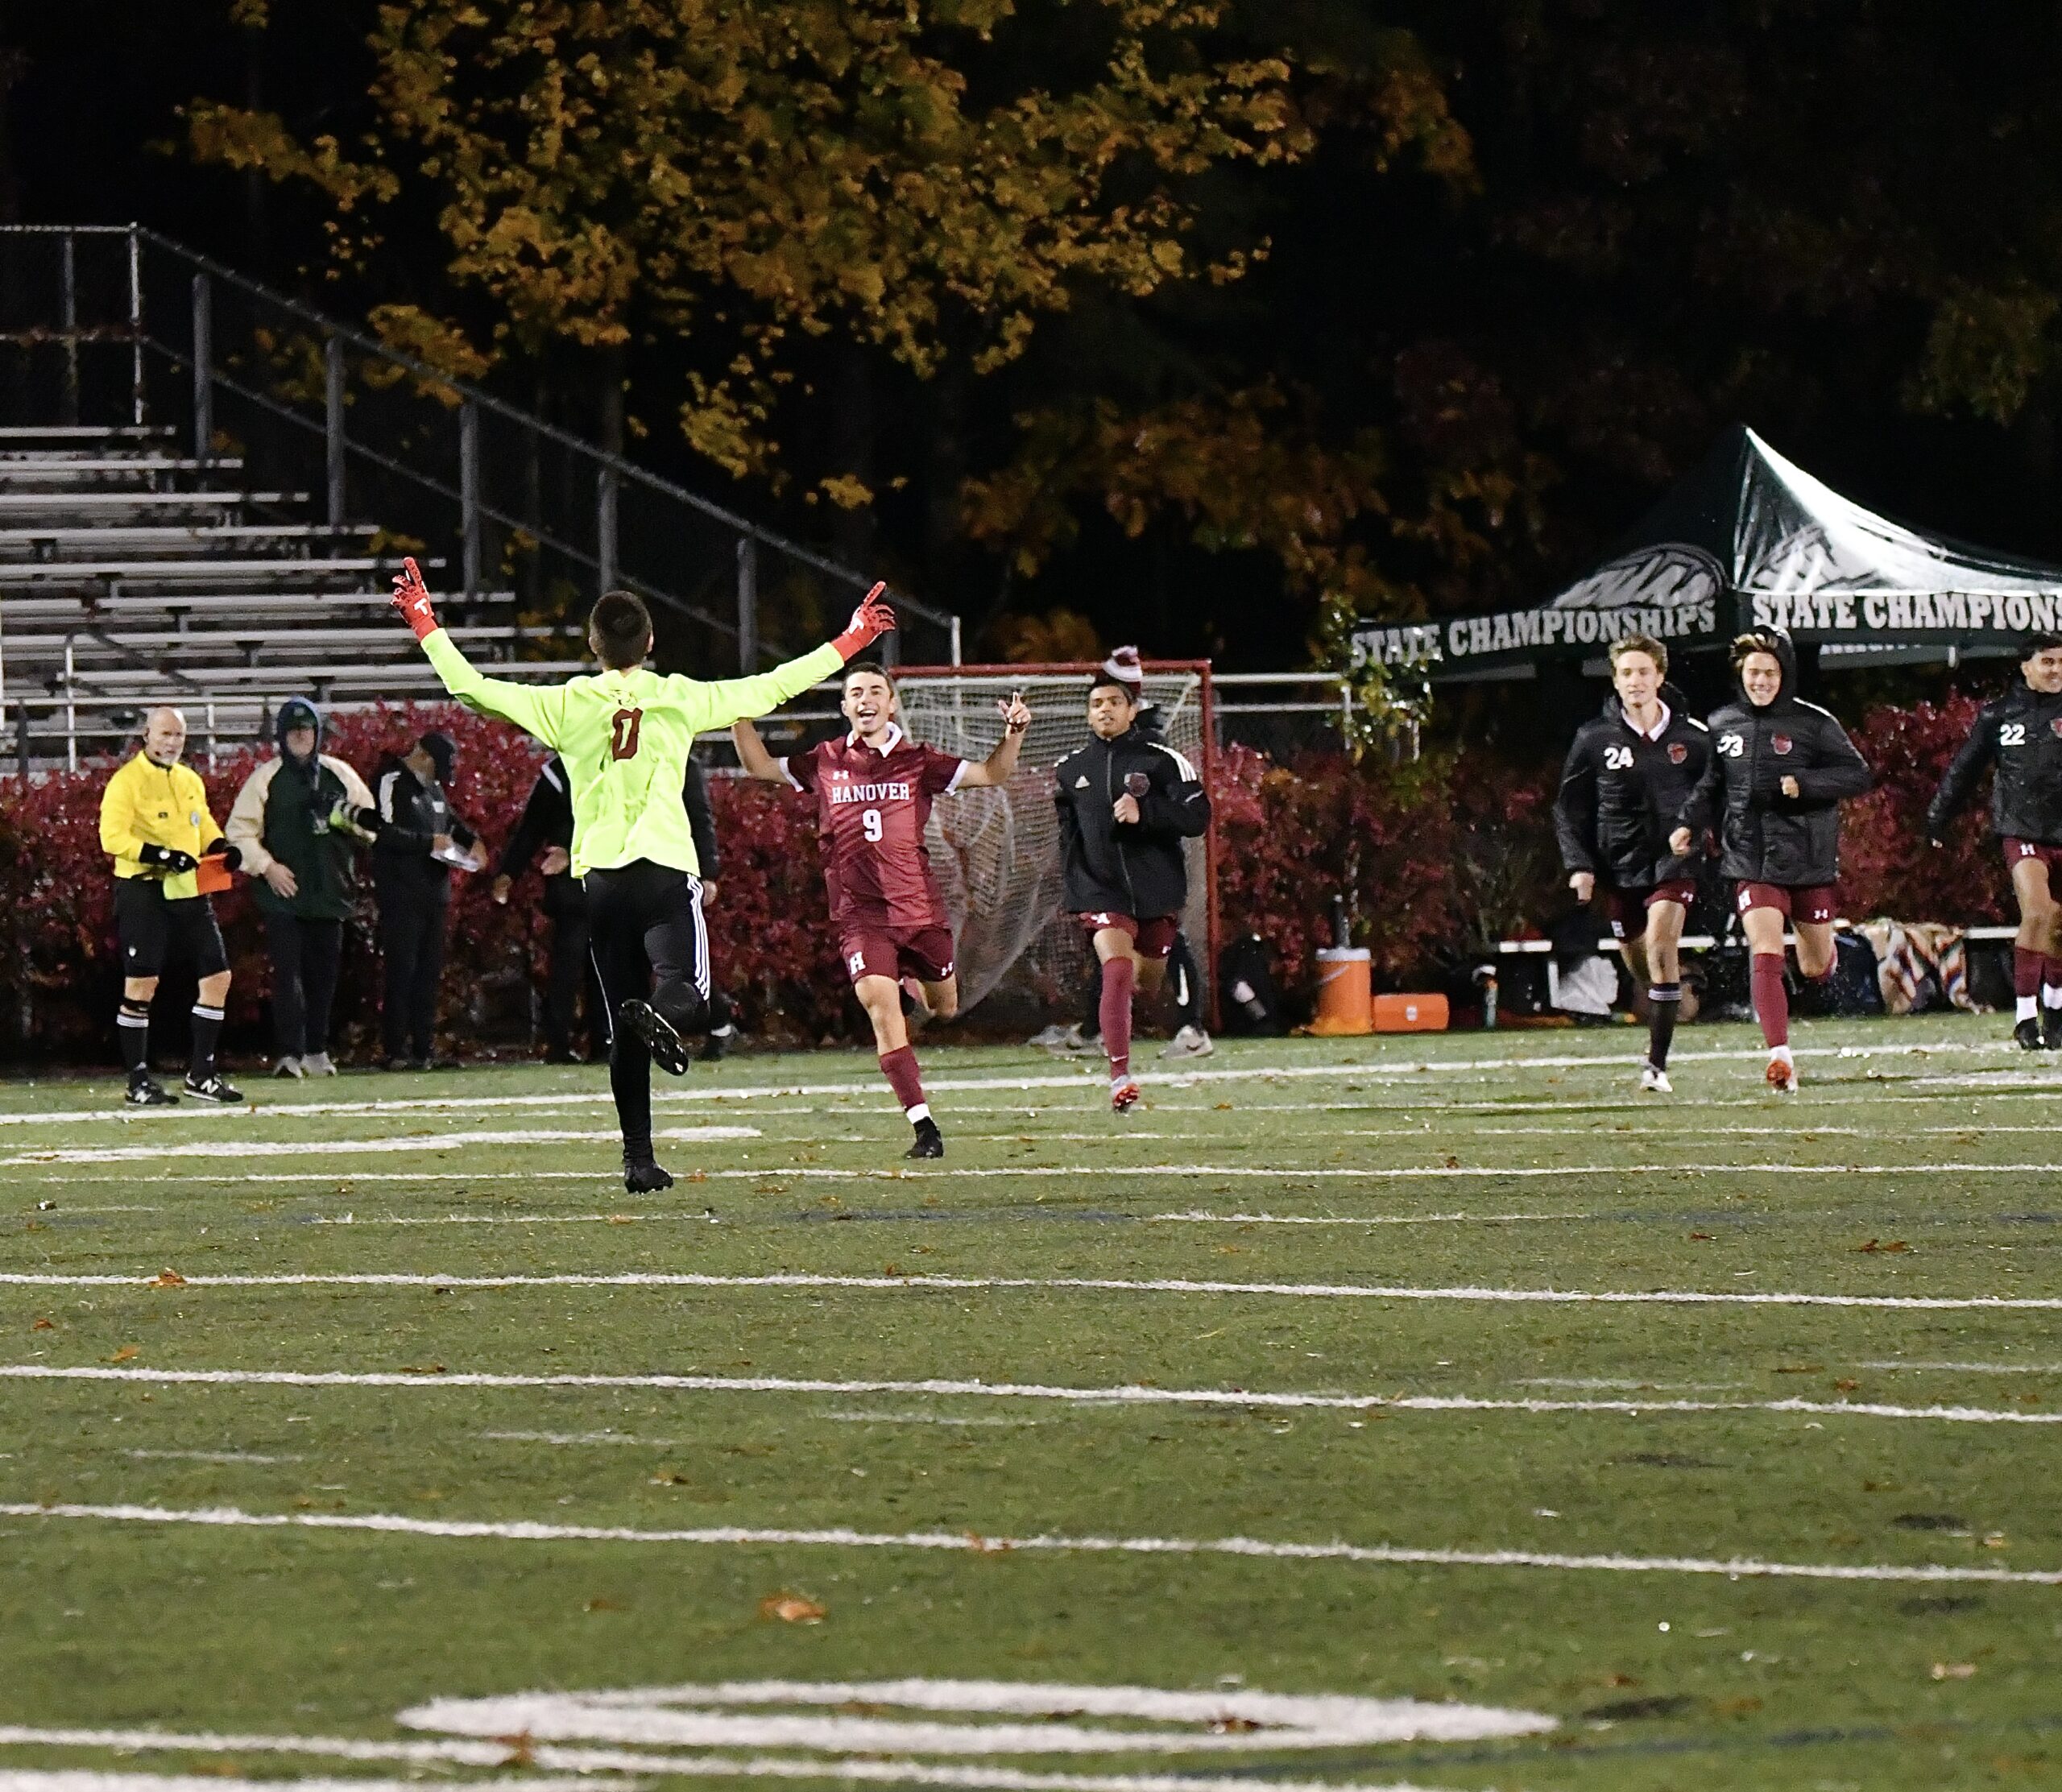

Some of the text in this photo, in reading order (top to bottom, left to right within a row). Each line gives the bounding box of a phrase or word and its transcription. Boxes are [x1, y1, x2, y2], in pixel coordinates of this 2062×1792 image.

[1752, 594, 1856, 629] STATE
[1350, 598, 1716, 668] STATE CHAMPIONSHIPS
[612, 707, 644, 762] 0
[2000, 723, 2026, 747] 22
[1604, 746, 1634, 770] 24
[832, 782, 911, 805] HANOVER
[862, 809, 883, 842] 9
